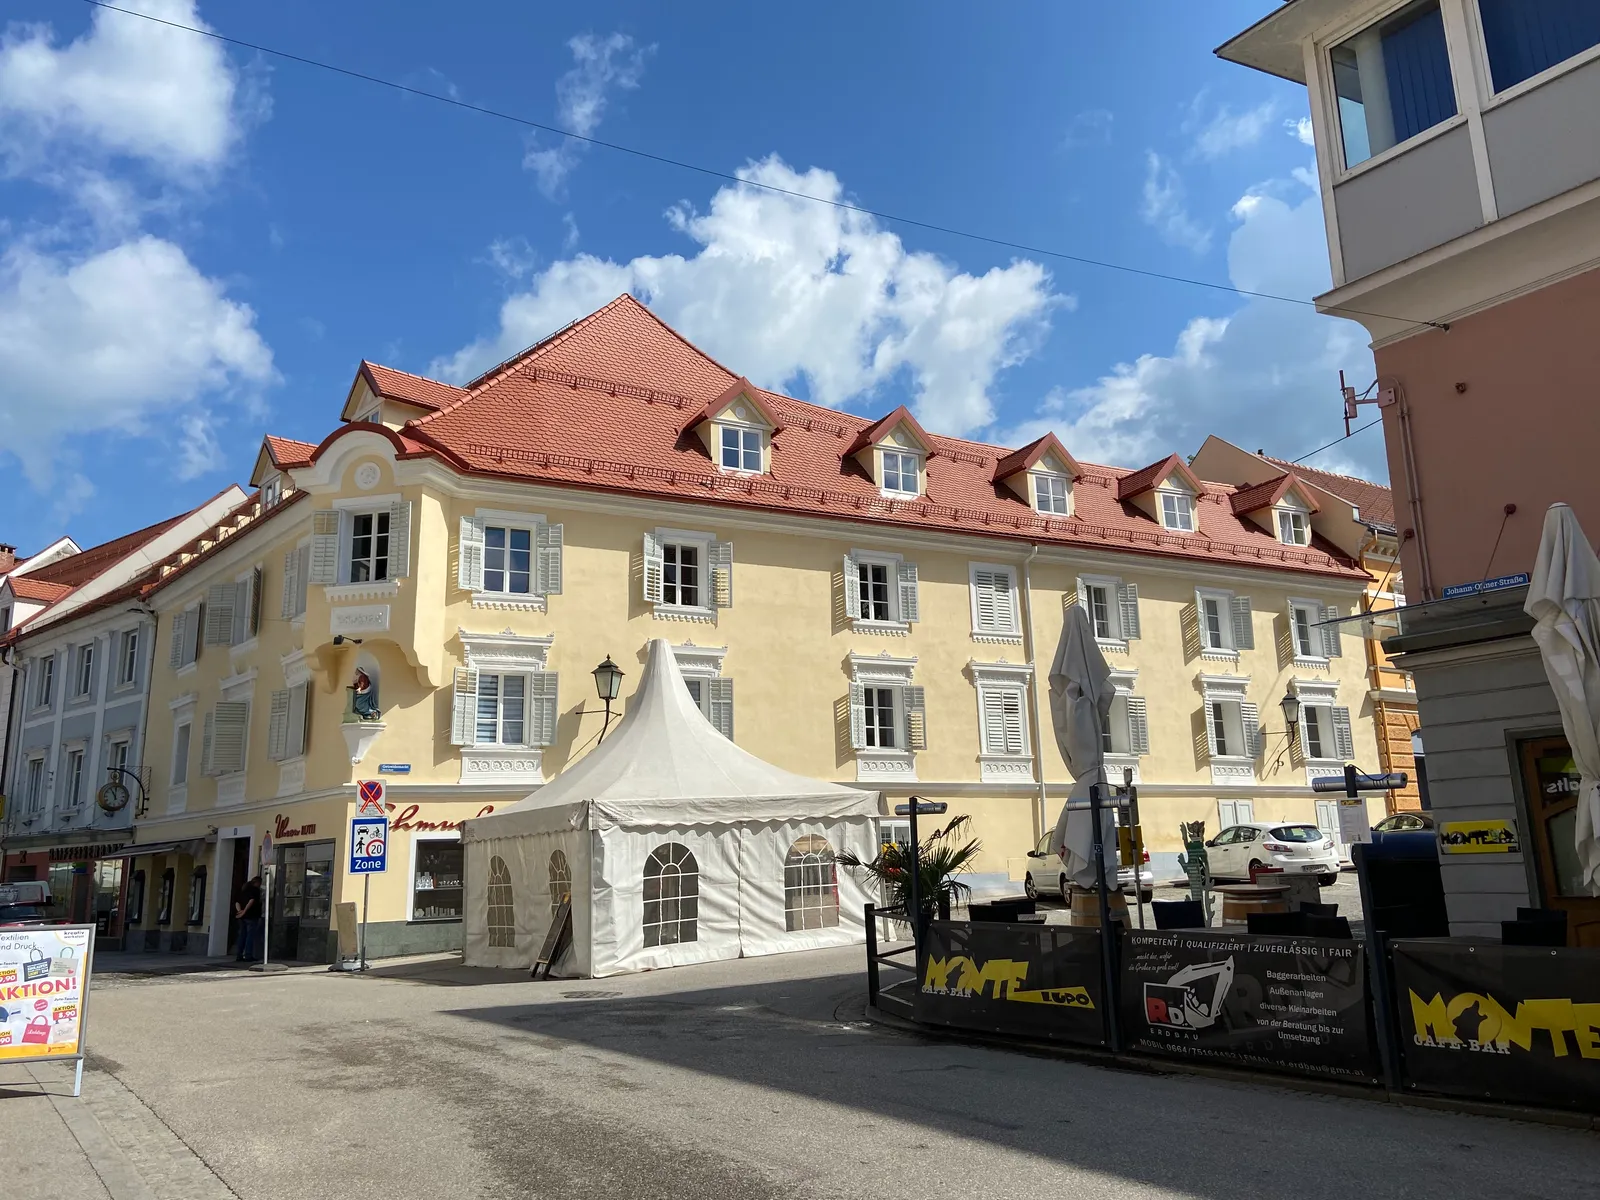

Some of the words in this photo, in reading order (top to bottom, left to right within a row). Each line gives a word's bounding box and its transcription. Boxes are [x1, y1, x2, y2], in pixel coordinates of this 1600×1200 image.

[371, 844, 382, 854] 20
[355, 860, 382, 870] Zone
[1132, 937, 1178, 947] KOMPETENT
[1186, 940, 1245, 951] QUALIFIZIERT
[1254, 944, 1318, 956] ZUVERLÄSSIG
[1329, 948, 1352, 957] FAIR
[924, 953, 1029, 1000] MONTE
[1266, 970, 1326, 982] Baggerarbeiten
[0, 977, 76, 1000] AKTION!
[1270, 987, 1324, 999] Außenanlagen
[1041, 992, 1089, 1005] LUPO
[1260, 1002, 1286, 1012] diverse
[1288, 1004, 1337, 1016] Kleinarbeiten
[1270, 1019, 1282, 1027] der
[1283, 1020, 1317, 1033] Beratung
[1319, 1024, 1330, 1033] bis
[1332, 1026, 1344, 1035] zur
[1408, 987, 1600, 1060] MONTE
[1150, 1028, 1198, 1040] ERDBAU
[1278, 1031, 1320, 1045] Umsetzung
